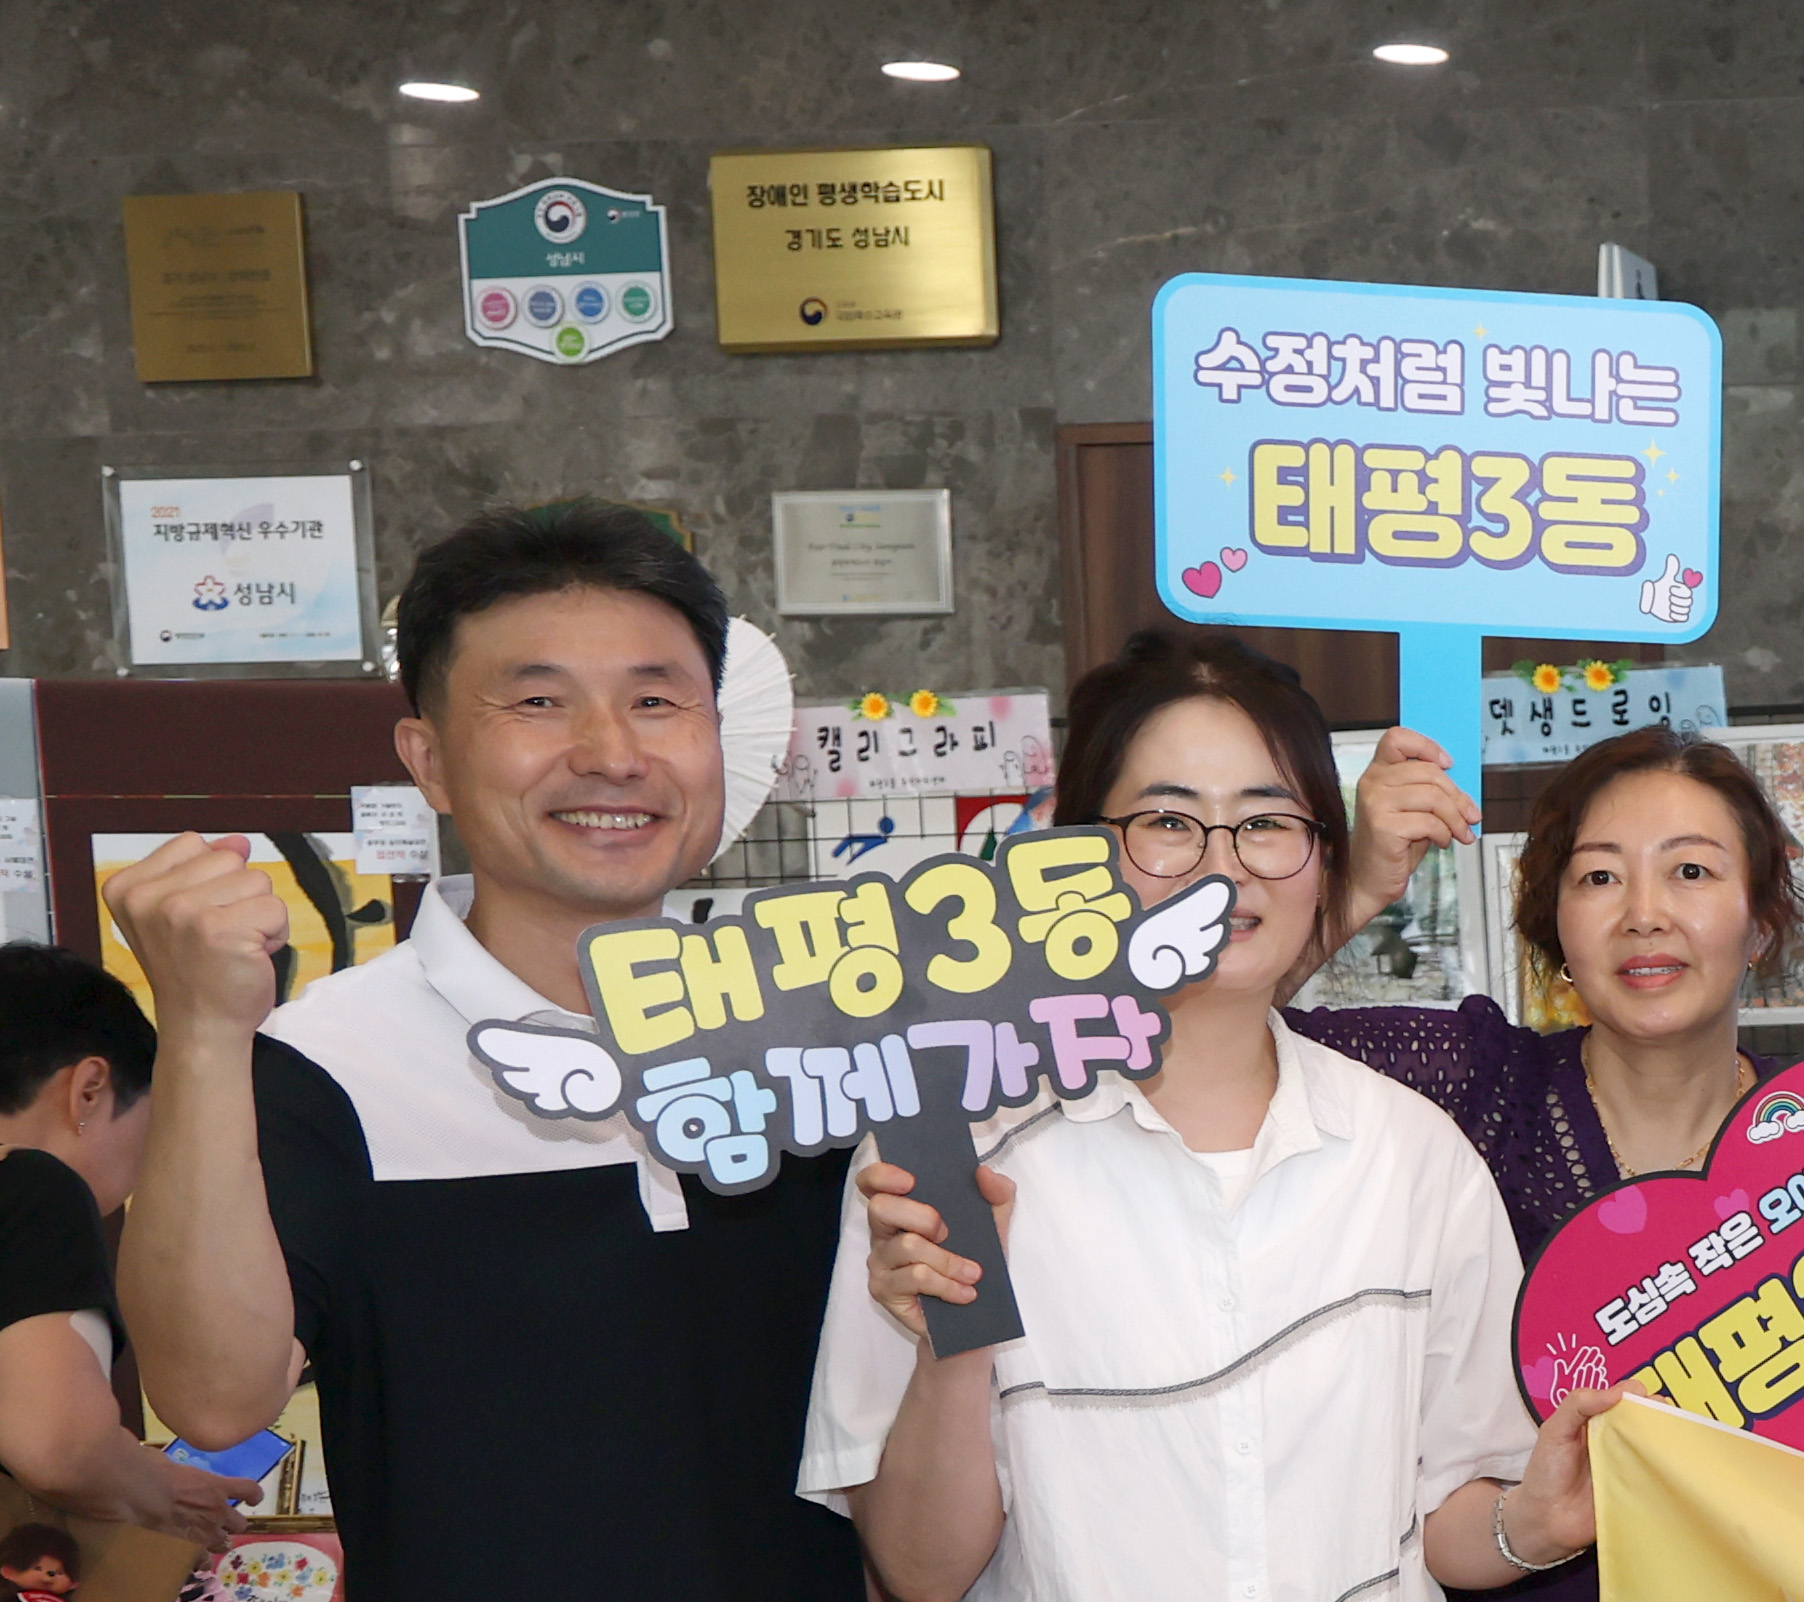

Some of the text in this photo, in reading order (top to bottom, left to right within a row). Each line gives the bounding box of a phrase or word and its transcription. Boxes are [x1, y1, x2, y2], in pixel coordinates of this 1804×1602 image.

[747, 179, 945, 208] 장애인 평생학습도시
[785, 226, 910, 251] 경기도 성남시
[1194, 327, 1681, 427] 수정처럼 빛나는
[151, 506, 180, 518] 2021
[153, 520, 324, 542] 지방규제혁신 우수기관
[1249, 438, 1648, 577] 태평3동
[233, 582, 296, 606] 성남시
[589, 835, 1132, 1055] 태평3동
[637, 994, 1161, 1185] 함께가자
[1595, 1262, 1698, 1346] 도심속
[1688, 1210, 1765, 1277] 작은
